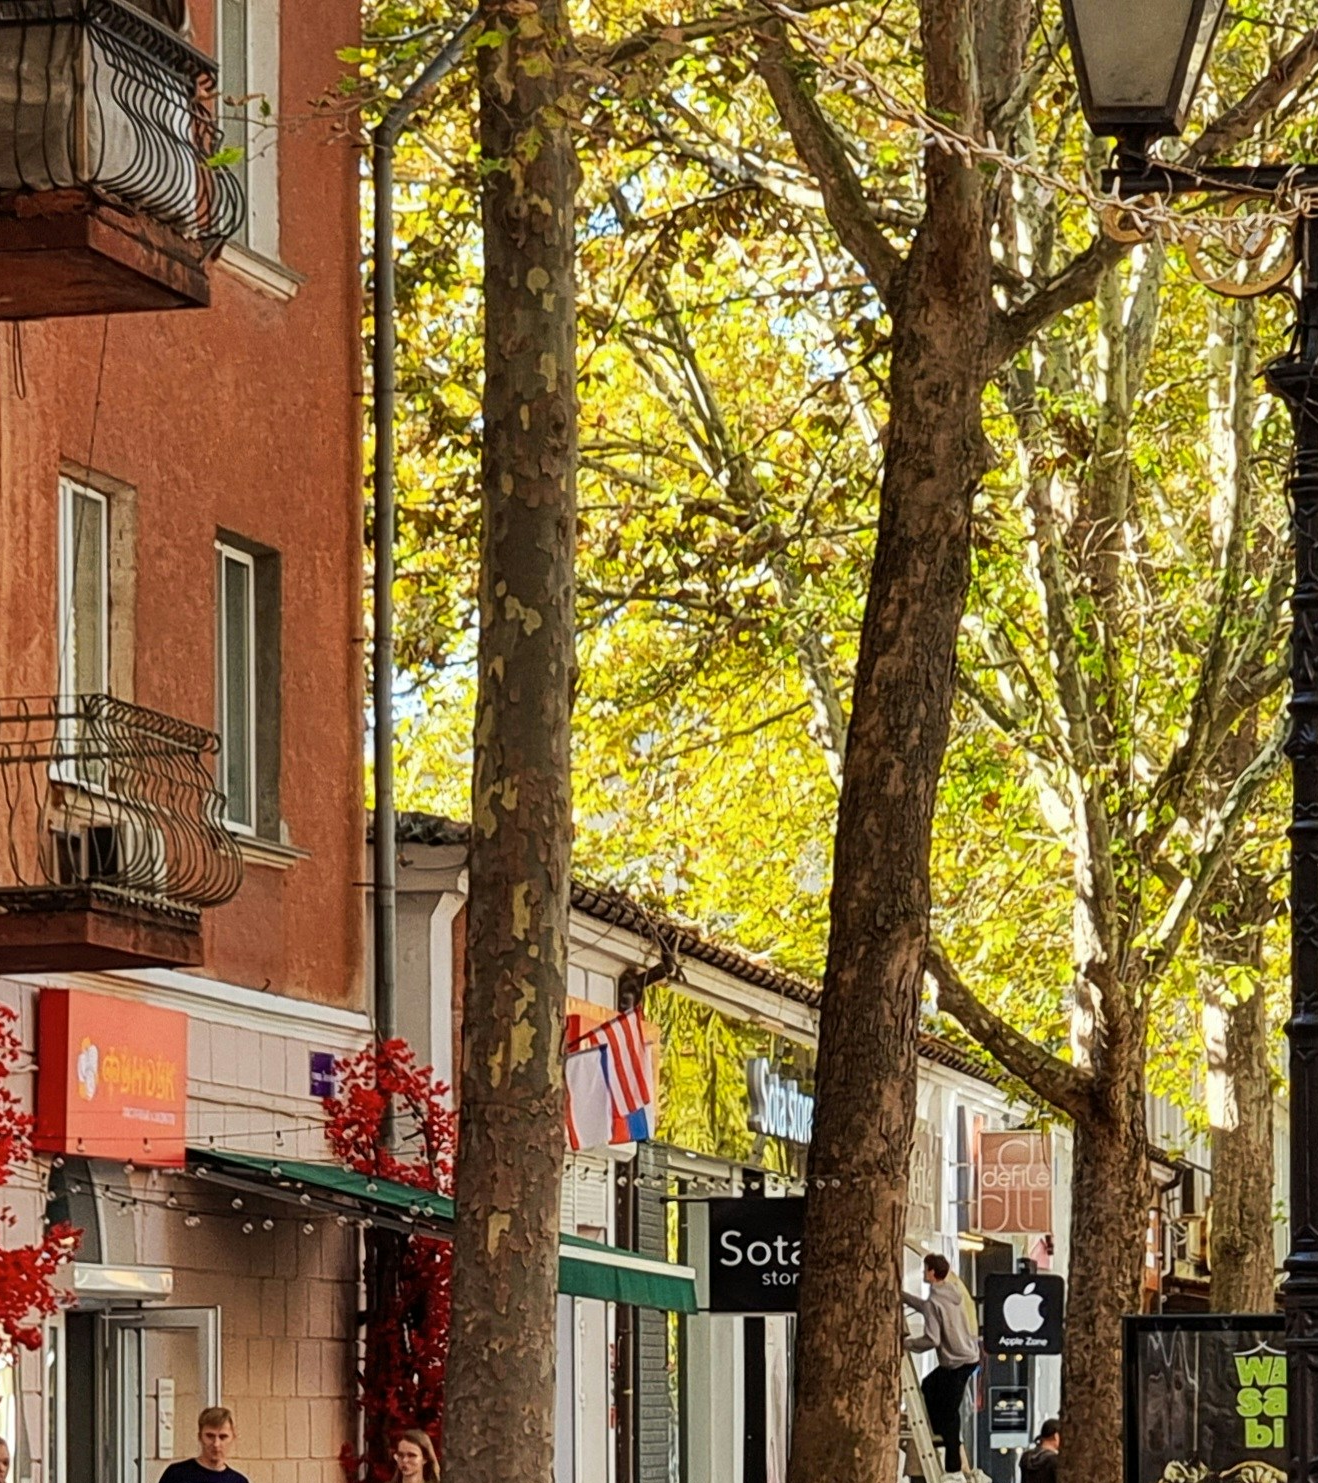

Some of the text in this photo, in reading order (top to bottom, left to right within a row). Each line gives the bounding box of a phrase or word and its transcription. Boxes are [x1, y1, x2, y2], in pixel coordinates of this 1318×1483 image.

[762, 1270, 799, 1286] stor
[998, 1336, 1048, 1347] Apple Zone
